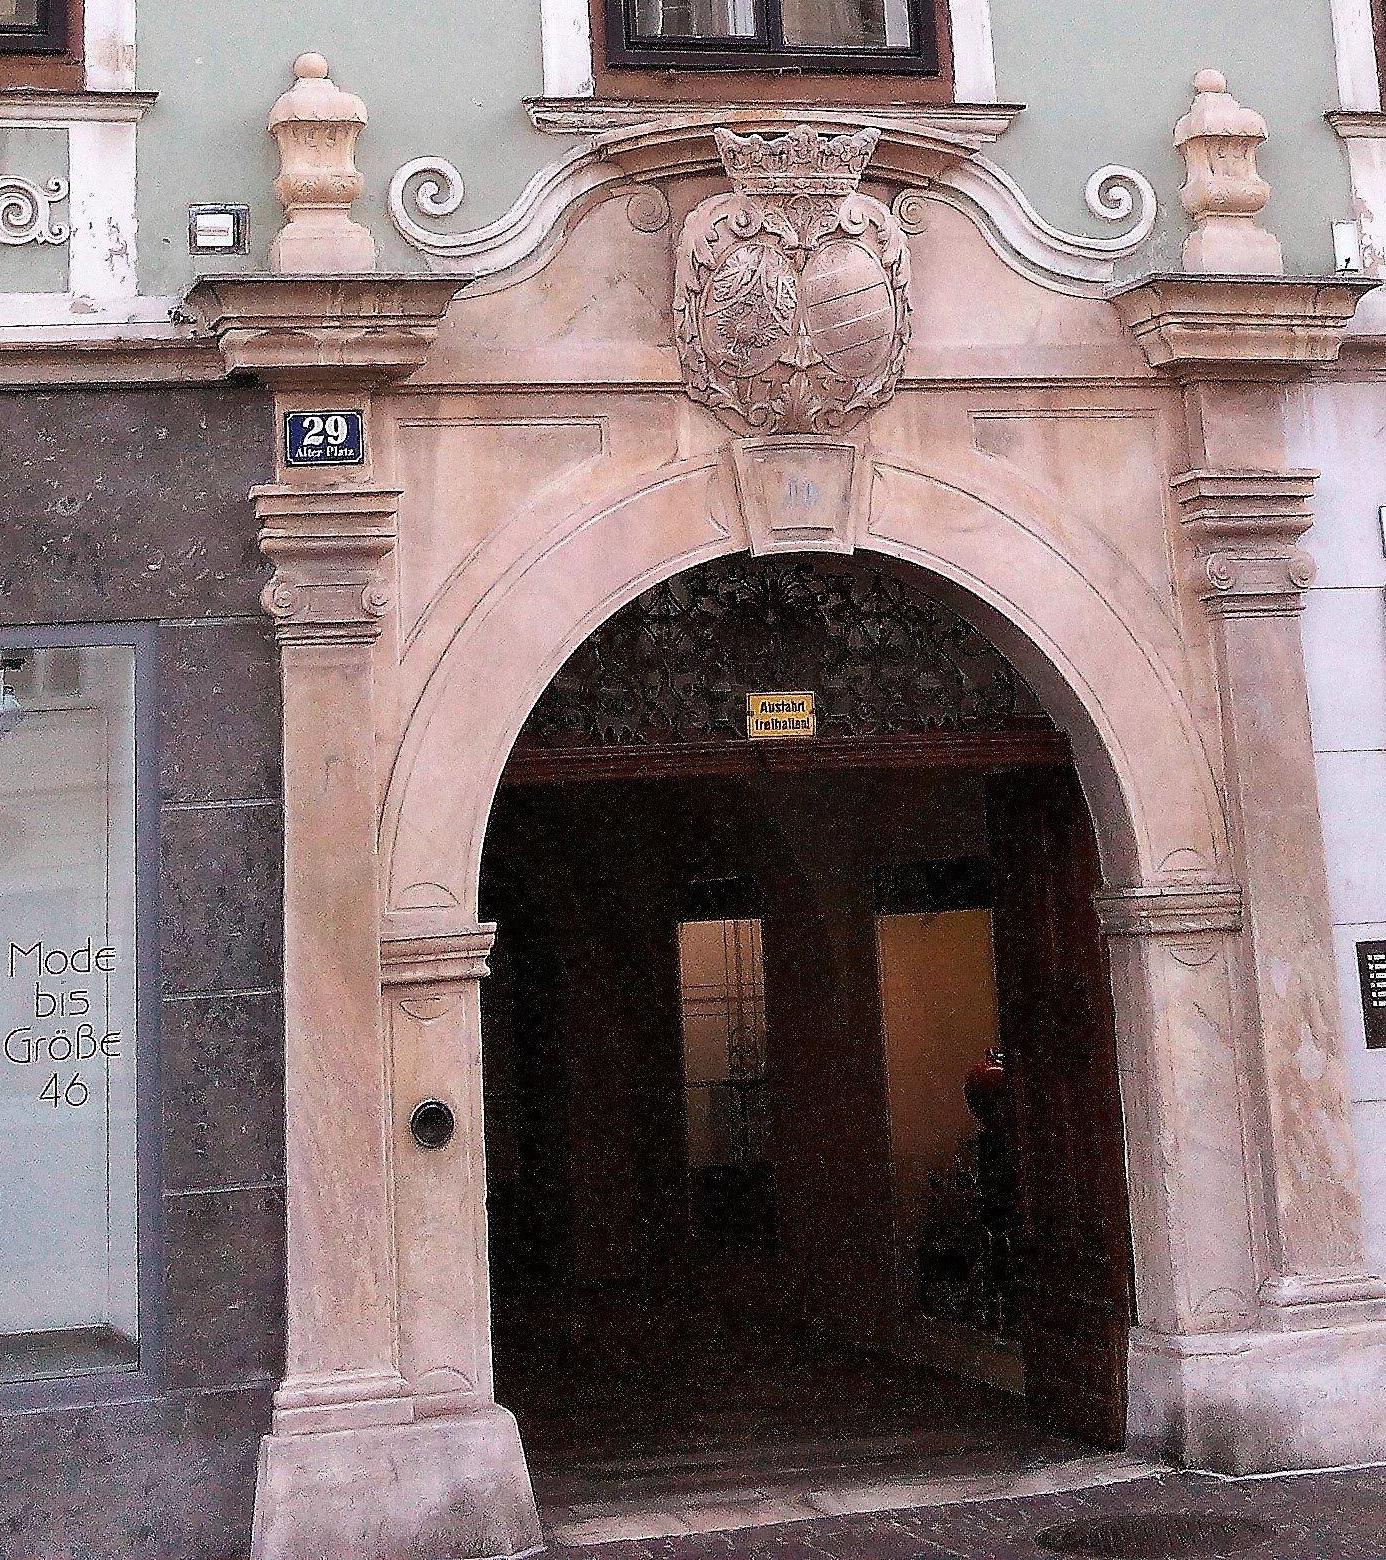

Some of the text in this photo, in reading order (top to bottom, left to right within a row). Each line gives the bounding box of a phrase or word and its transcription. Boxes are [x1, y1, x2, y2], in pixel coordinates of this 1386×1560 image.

[302, 415, 348, 446] 29
[295, 445, 354, 458] Alter Platz
[10, 937, 116, 977] Mode
[35, 981, 90, 1018] bis
[4, 1023, 121, 1064] Größe
[39, 1072, 89, 1109] 46
